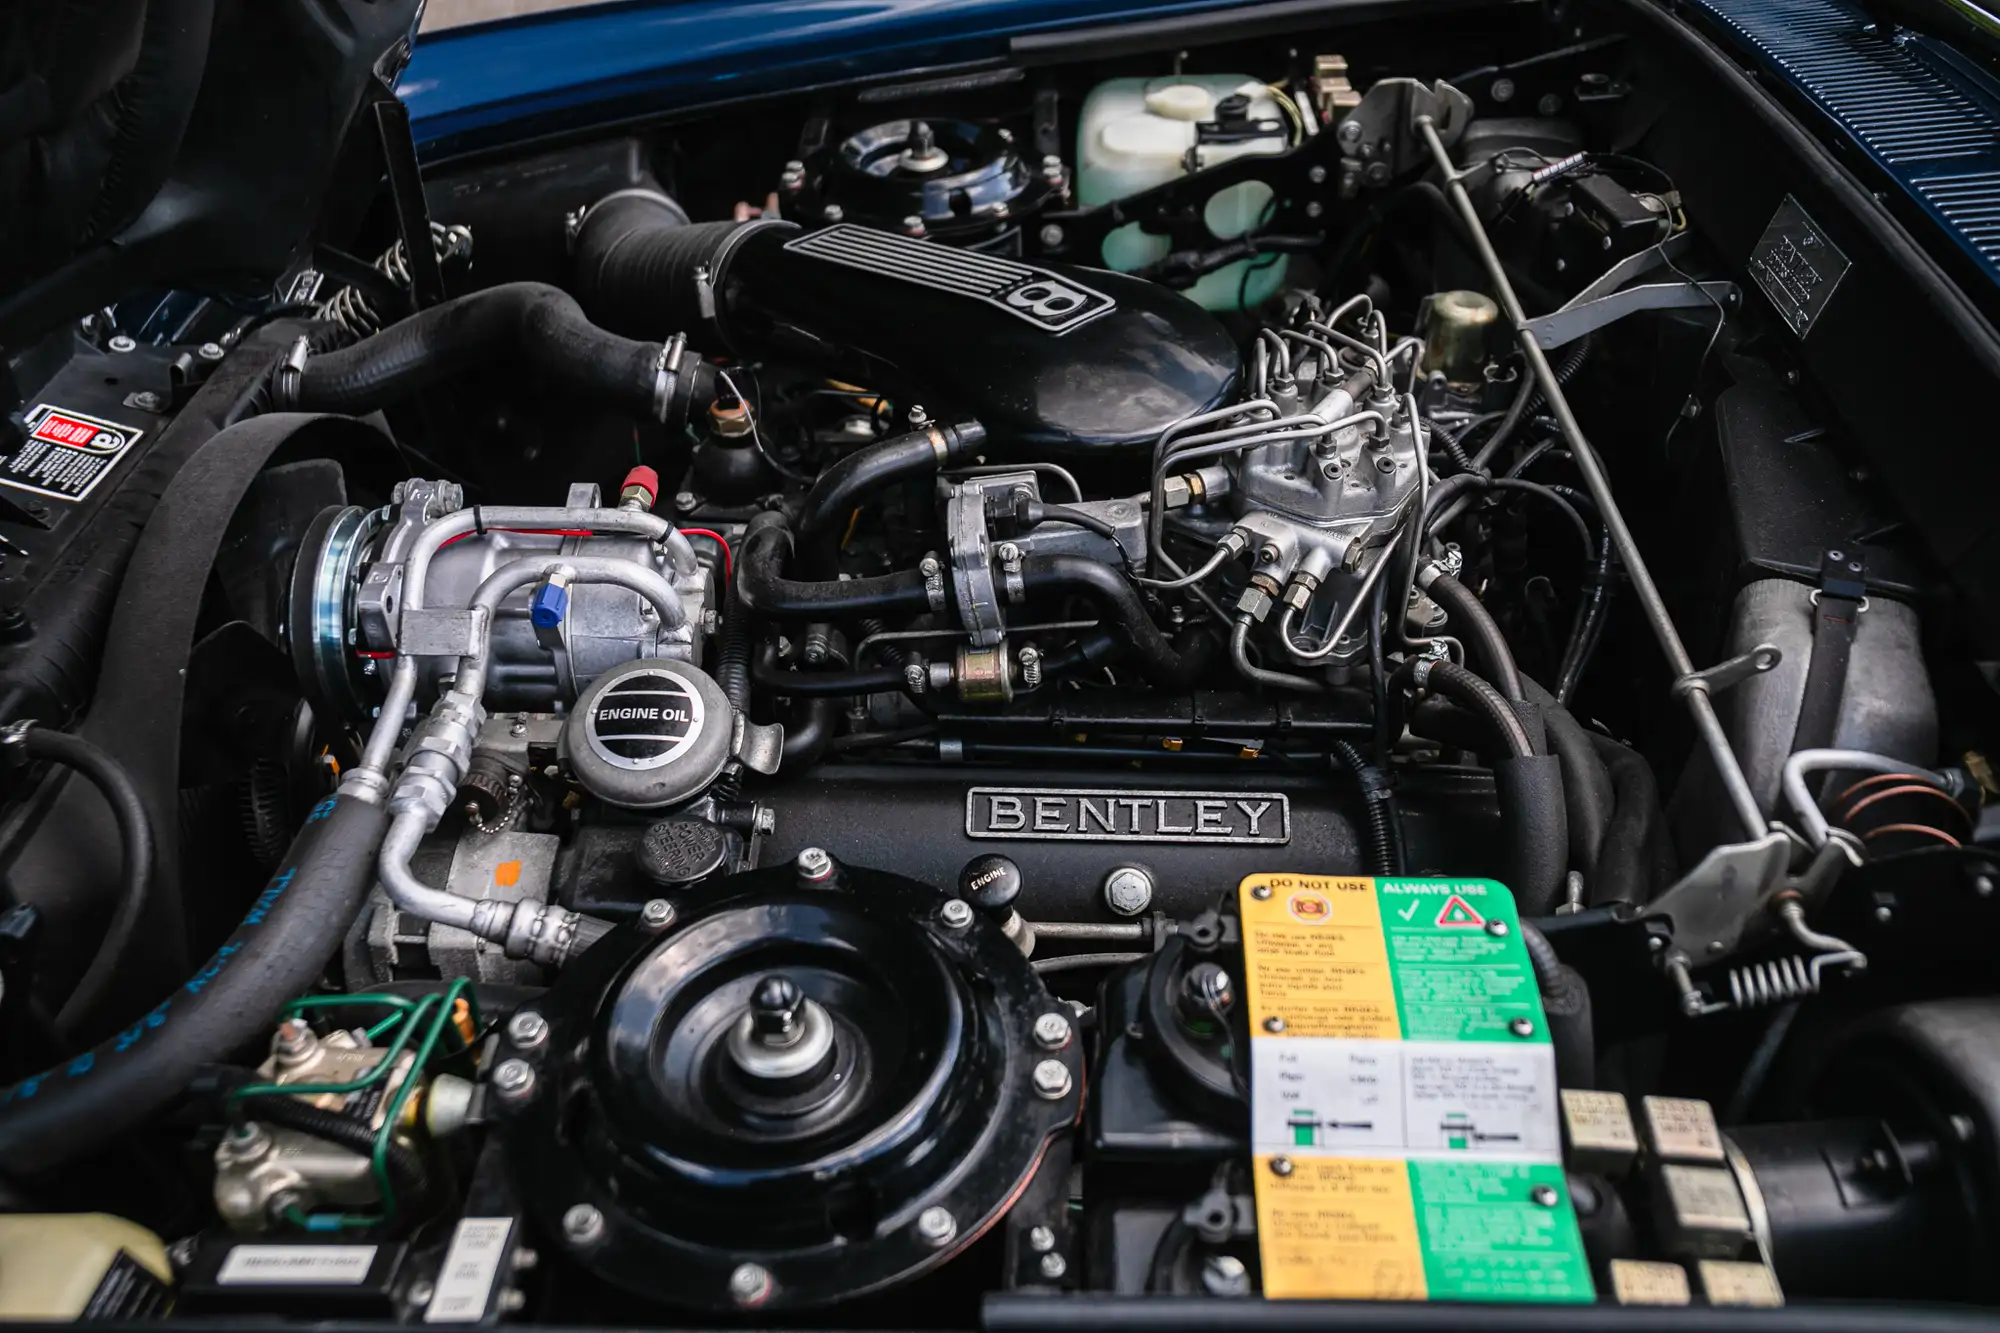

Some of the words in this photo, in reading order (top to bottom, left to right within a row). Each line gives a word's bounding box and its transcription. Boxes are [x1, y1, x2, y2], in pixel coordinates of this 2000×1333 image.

[599, 708, 659, 721] ENGINE
[662, 708, 690, 722] OIL
[987, 795, 1271, 836] BENTLEY
[653, 823, 691, 877] STEERING
[674, 823, 705, 863] POWER
[970, 866, 1007, 891] ENGINE
[1270, 878, 1293, 889] DO
[1299, 880, 1330, 890] NOT
[1337, 883, 1368, 892] USE
[1383, 882, 1451, 895] ALWAYS
[1455, 884, 1488, 896] USE
